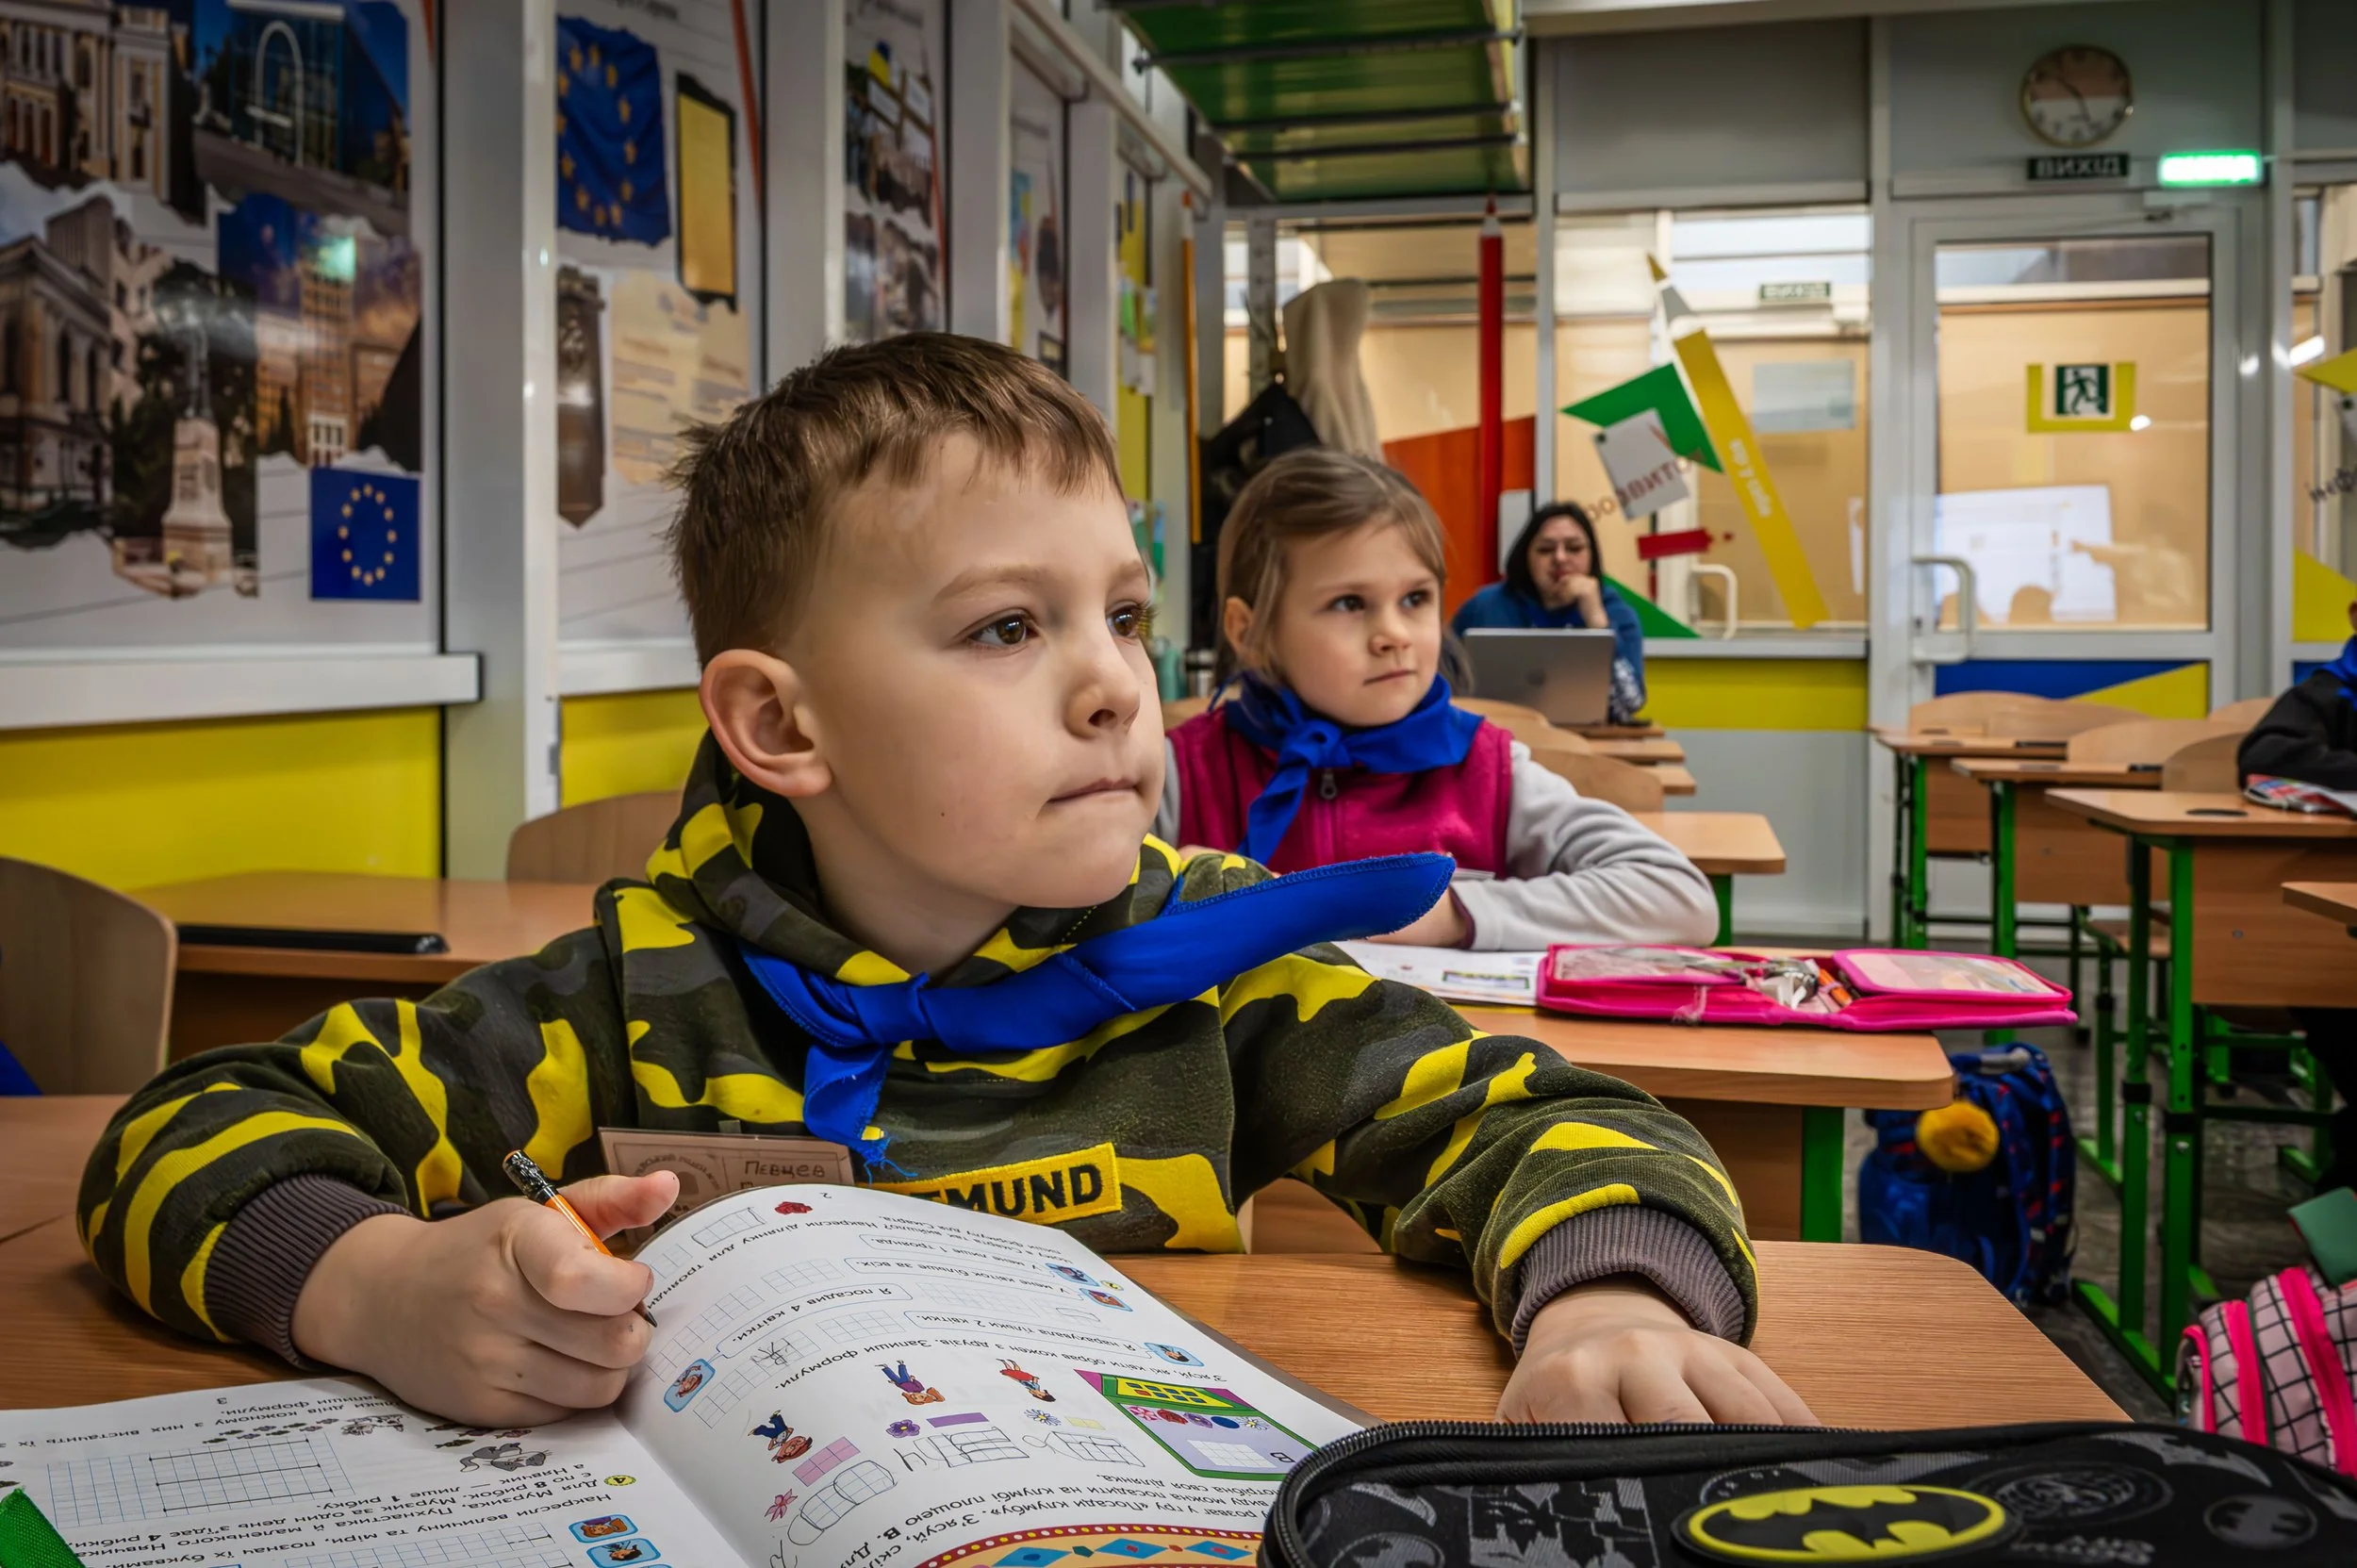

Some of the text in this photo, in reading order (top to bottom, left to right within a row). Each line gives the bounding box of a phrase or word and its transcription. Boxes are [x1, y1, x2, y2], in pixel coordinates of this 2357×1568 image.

[2035, 156, 2121, 177] ВИХІД
[908, 1164, 1103, 1216] MUND
[805, 1220, 879, 1229] Накресли
[884, 1224, 943, 1236] вийшло?
[743, 1224, 799, 1245] ділянку
[871, 1238, 935, 1250] троянда.
[708, 1245, 735, 1262] для
[952, 1248, 987, 1258] лише
[992, 1256, 1025, 1265] мене
[917, 1263, 969, 1277] більше
[971, 1271, 1016, 1283] квіток
[1019, 1279, 1054, 1290] мене
[806, 1288, 874, 1305] посадив
[916, 1315, 969, 1324] квітки.
[733, 1311, 786, 1342] квітки.
[988, 1322, 1035, 1333] тільки
[934, 1339, 990, 1348] друзів.
[1038, 1328, 1120, 1347] нарахувала
[864, 1339, 932, 1352] Запиши
[1009, 1345, 1058, 1358] кожен
[1062, 1354, 1106, 1365] обрав
[774, 1349, 858, 1390] формули.
[1110, 1362, 1146, 1373] квіти
[221, 1401, 309, 1416] формули.
[307, 1405, 344, 1414] днів
[215, 1411, 298, 1426] кожному
[151, 1424, 185, 1433] них
[45, 1429, 140, 1444] вистачить
[1269, 1452, 1297, 1463] В
[500, 1467, 568, 1484] Нявчик
[552, 1475, 575, 1483] по
[1096, 1473, 1166, 1488] ділянка.
[534, 1480, 548, 1489] 8
[561, 1478, 598, 1492] Для
[1058, 1486, 1082, 1494] на
[1170, 1482, 1209, 1492] своя
[409, 1486, 460, 1497] лише
[462, 1484, 528, 1499] рибок.
[992, 1488, 1054, 1503] клумбі
[1087, 1486, 1167, 1499] посадити
[317, 1495, 382, 1510] рибку.
[381, 1497, 456, 1512] Мурзик
[462, 1489, 553, 1510] Мурзика,
[517, 1494, 612, 1516] Накресли
[1073, 1499, 1148, 1512] «Посади
[1169, 1494, 1226, 1505] можна
[1230, 1497, 1269, 1507] виду
[904, 1495, 986, 1527] площею
[981, 1499, 1070, 1516] клумбу».
[1155, 1501, 1186, 1512] гру
[1187, 1505, 1199, 1514] у
[294, 1512, 345, 1523] один
[335, 1507, 453, 1527] Пухнастика
[1203, 1509, 1258, 1518] розваг
[238, 1518, 287, 1528] день
[417, 1514, 509, 1533] величину
[177, 1527, 302, 1546] маленького
[324, 1533, 378, 1544] міри,
[877, 1526, 901, 1541] В.
[69, 1535, 140, 1548] рибки.
[213, 1550, 234, 1559] їх
[243, 1541, 316, 1556] познач
[106, 1554, 206, 1568] буквами.
